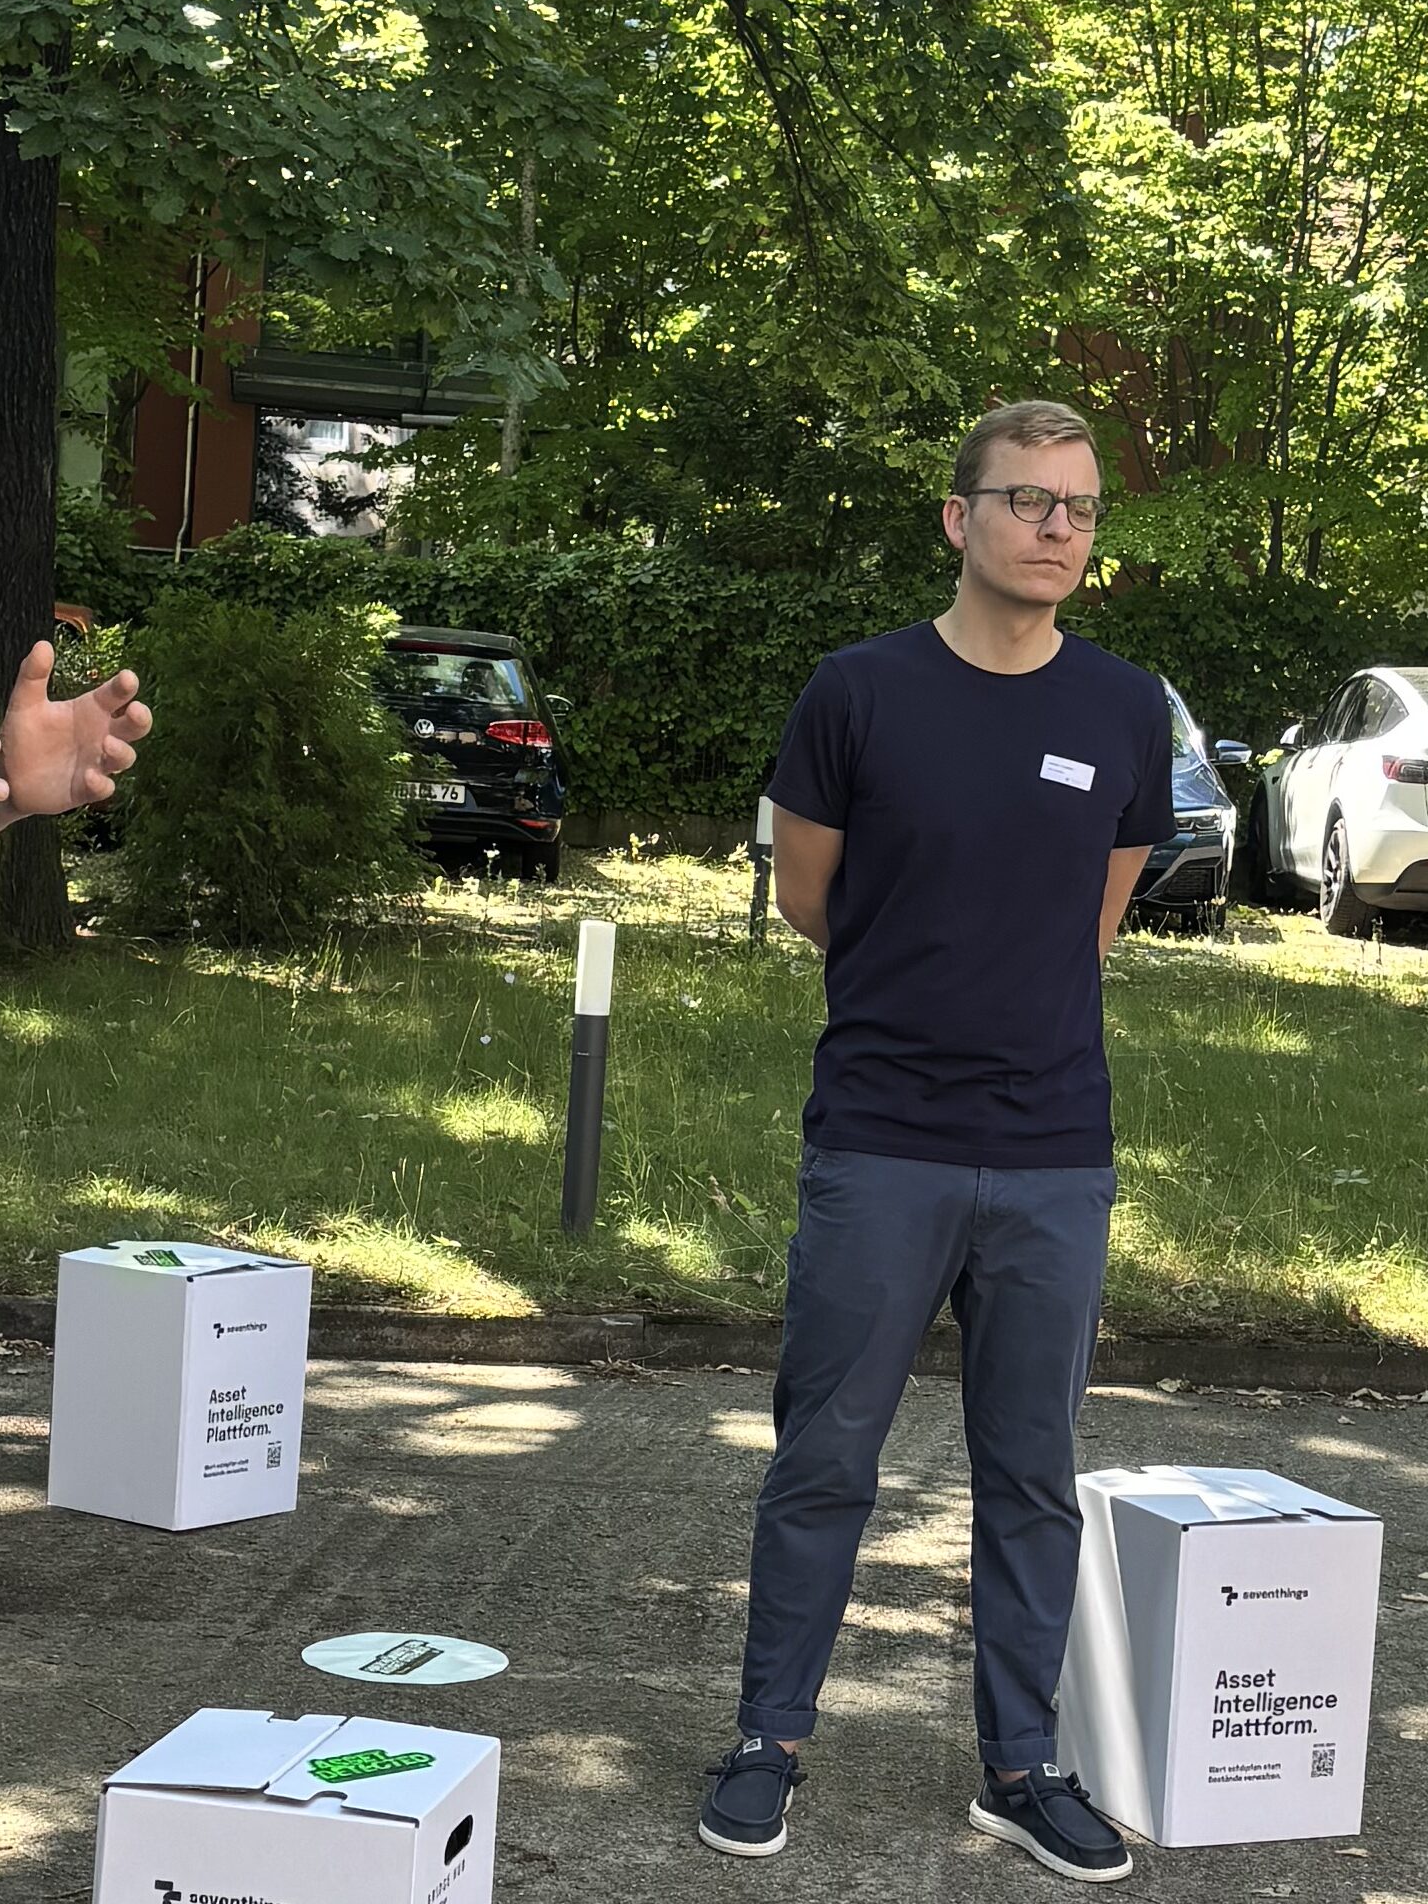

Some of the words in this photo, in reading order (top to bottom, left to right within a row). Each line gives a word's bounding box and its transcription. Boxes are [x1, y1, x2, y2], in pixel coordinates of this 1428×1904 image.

[441, 786, 458, 801] 76
[209, 1386, 247, 1404] Asset
[208, 1403, 284, 1424] Intelligence
[206, 1422, 272, 1443] Plattform.
[1242, 1587, 1309, 1600] seventhings
[1215, 1669, 1276, 1689] Asset
[1213, 1692, 1338, 1716] Intelligence
[1212, 1716, 1318, 1738] Plattform.
